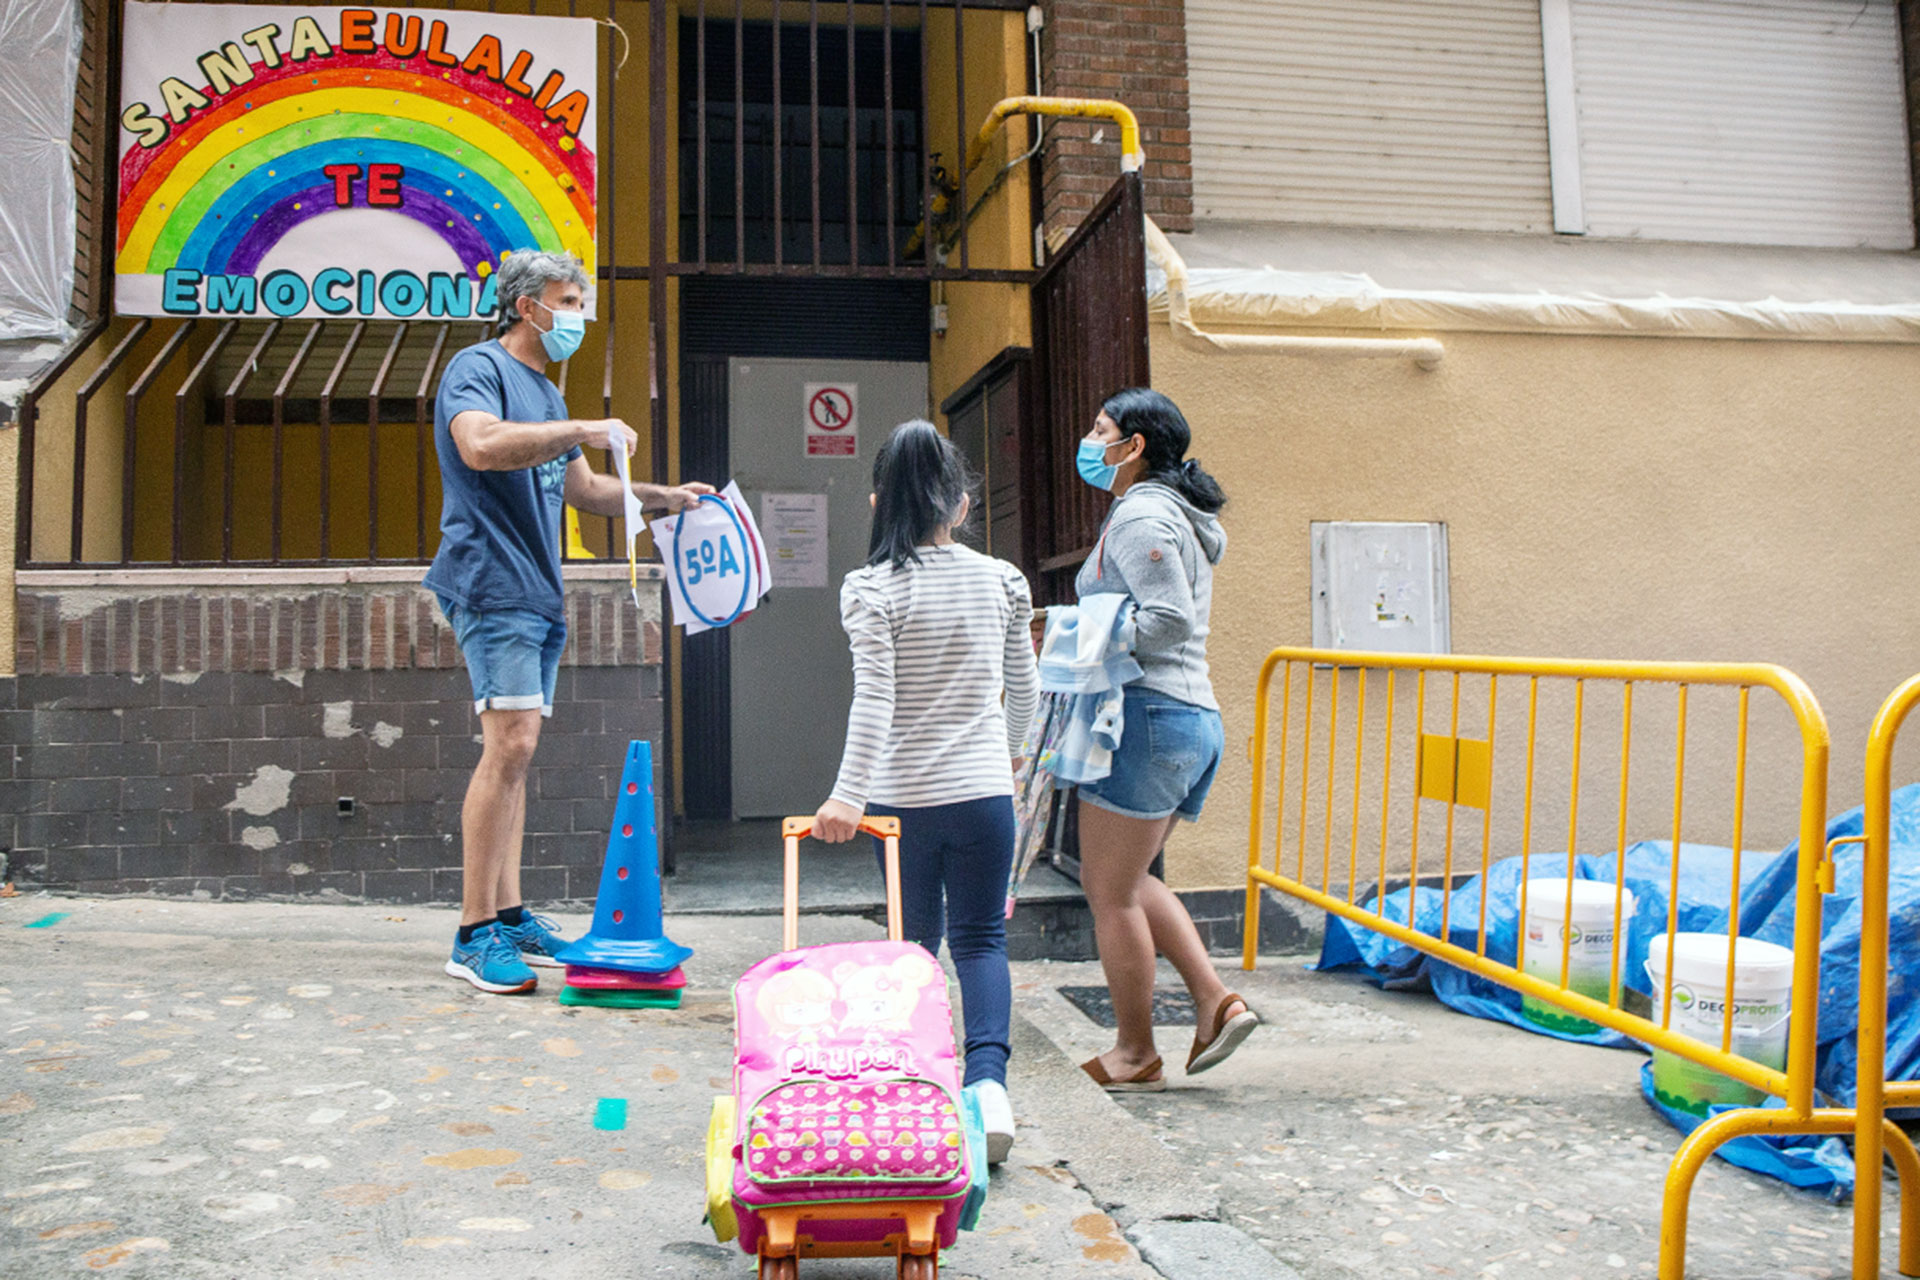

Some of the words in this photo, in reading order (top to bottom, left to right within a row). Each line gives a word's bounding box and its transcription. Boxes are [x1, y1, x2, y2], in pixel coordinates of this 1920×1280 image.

[121, 17, 333, 148] SANTA
[340, 9, 590, 138] EULALIA
[323, 163, 404, 209] TE
[162, 267, 498, 319] EMOCIONA
